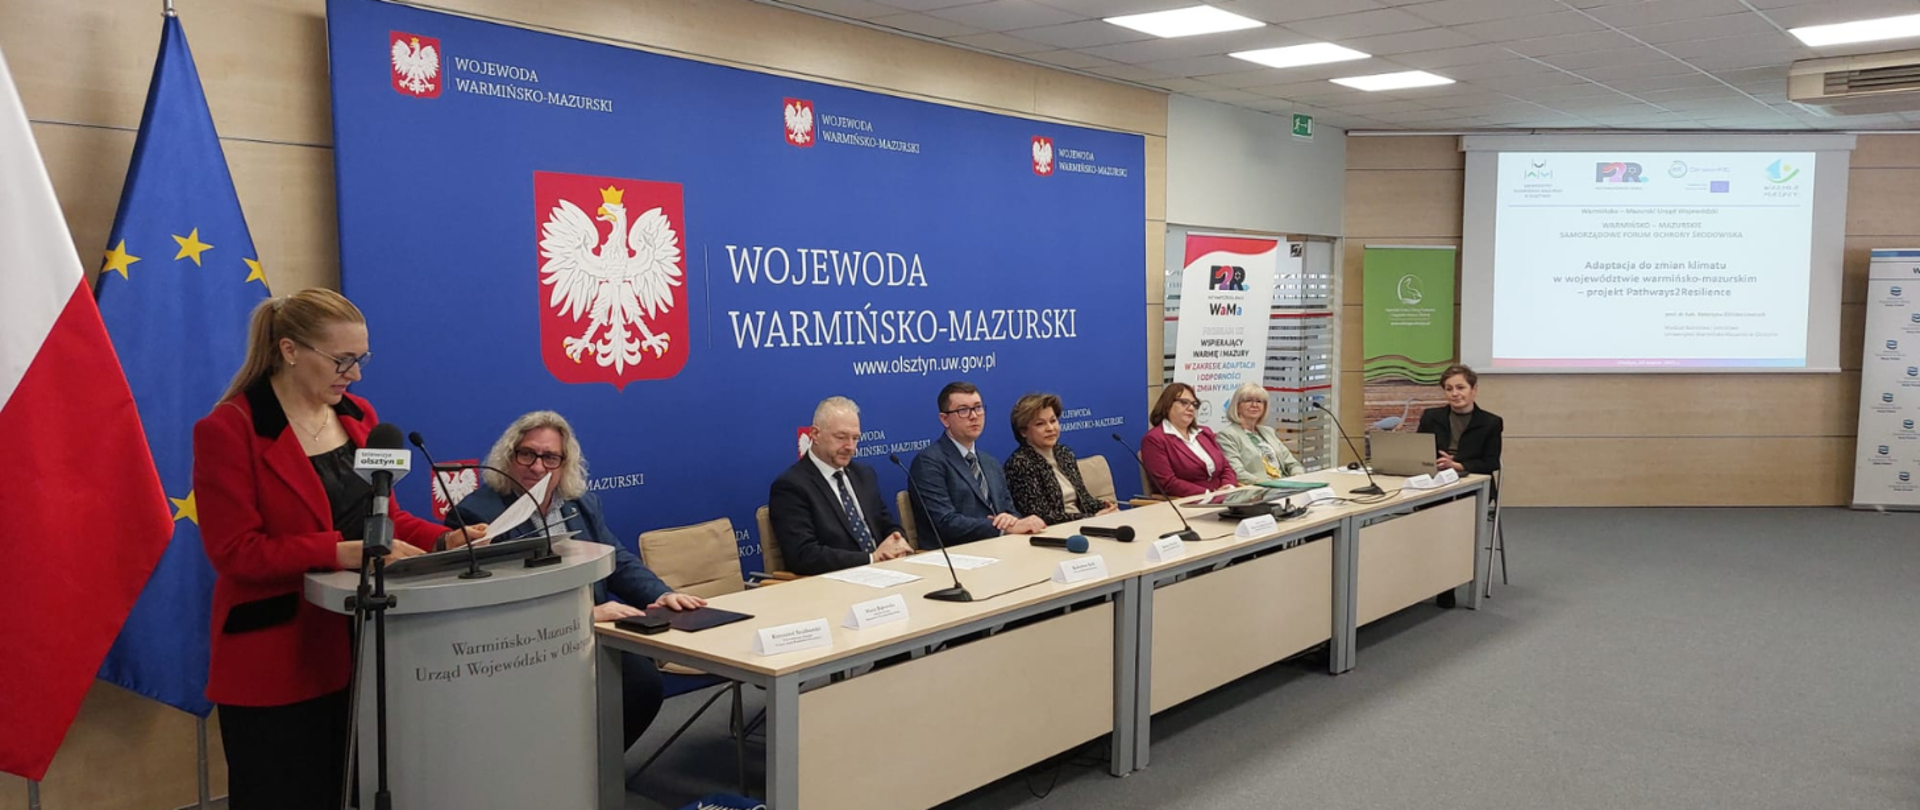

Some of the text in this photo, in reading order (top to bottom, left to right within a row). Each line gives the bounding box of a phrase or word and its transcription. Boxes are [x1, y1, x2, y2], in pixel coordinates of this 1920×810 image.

[454, 57, 539, 83] WOJEWODA
[455, 78, 613, 113] WARMIŃSKO-MAZURSKI
[821, 113, 873, 132] WOJEWODA
[822, 130, 920, 154] WARMIŃSKO-MAZURSKI
[1058, 148, 1095, 161] WOJEWODA
[1559, 229, 1743, 240] SAMORZĄDOWE FORUM OCHRONY ŚRODOWISKA
[725, 244, 928, 287] WOJEWODA
[1585, 260, 1727, 272] Adaptacja do zmian klimatu
[1565, 273, 1640, 285] województwie
[1642, 273, 1758, 283] warmińsko-mazurskim
[1586, 286, 1624, 299] projekt
[1626, 286, 1732, 298] Pathways2Resilience
[1209, 303, 1243, 316] WaMa
[728, 302, 1077, 349] WARMIŃSKO-MAZURSKI
[1200, 338, 1244, 348] WSPIERAJĄCY
[1193, 350, 1219, 359] WARMIĘ
[1222, 349, 1250, 357] MAZURY
[853, 351, 997, 377] www.olsztyn.uw.gov.pl
[1192, 362, 1222, 370] ZAKRESIE
[361, 458, 395, 466] olsztyn
[452, 617, 581, 657] Warmińsko-Mazurski
[415, 666, 461, 682] Urząd
[467, 650, 547, 678] Wojewódzki
[550, 650, 558, 659] w
